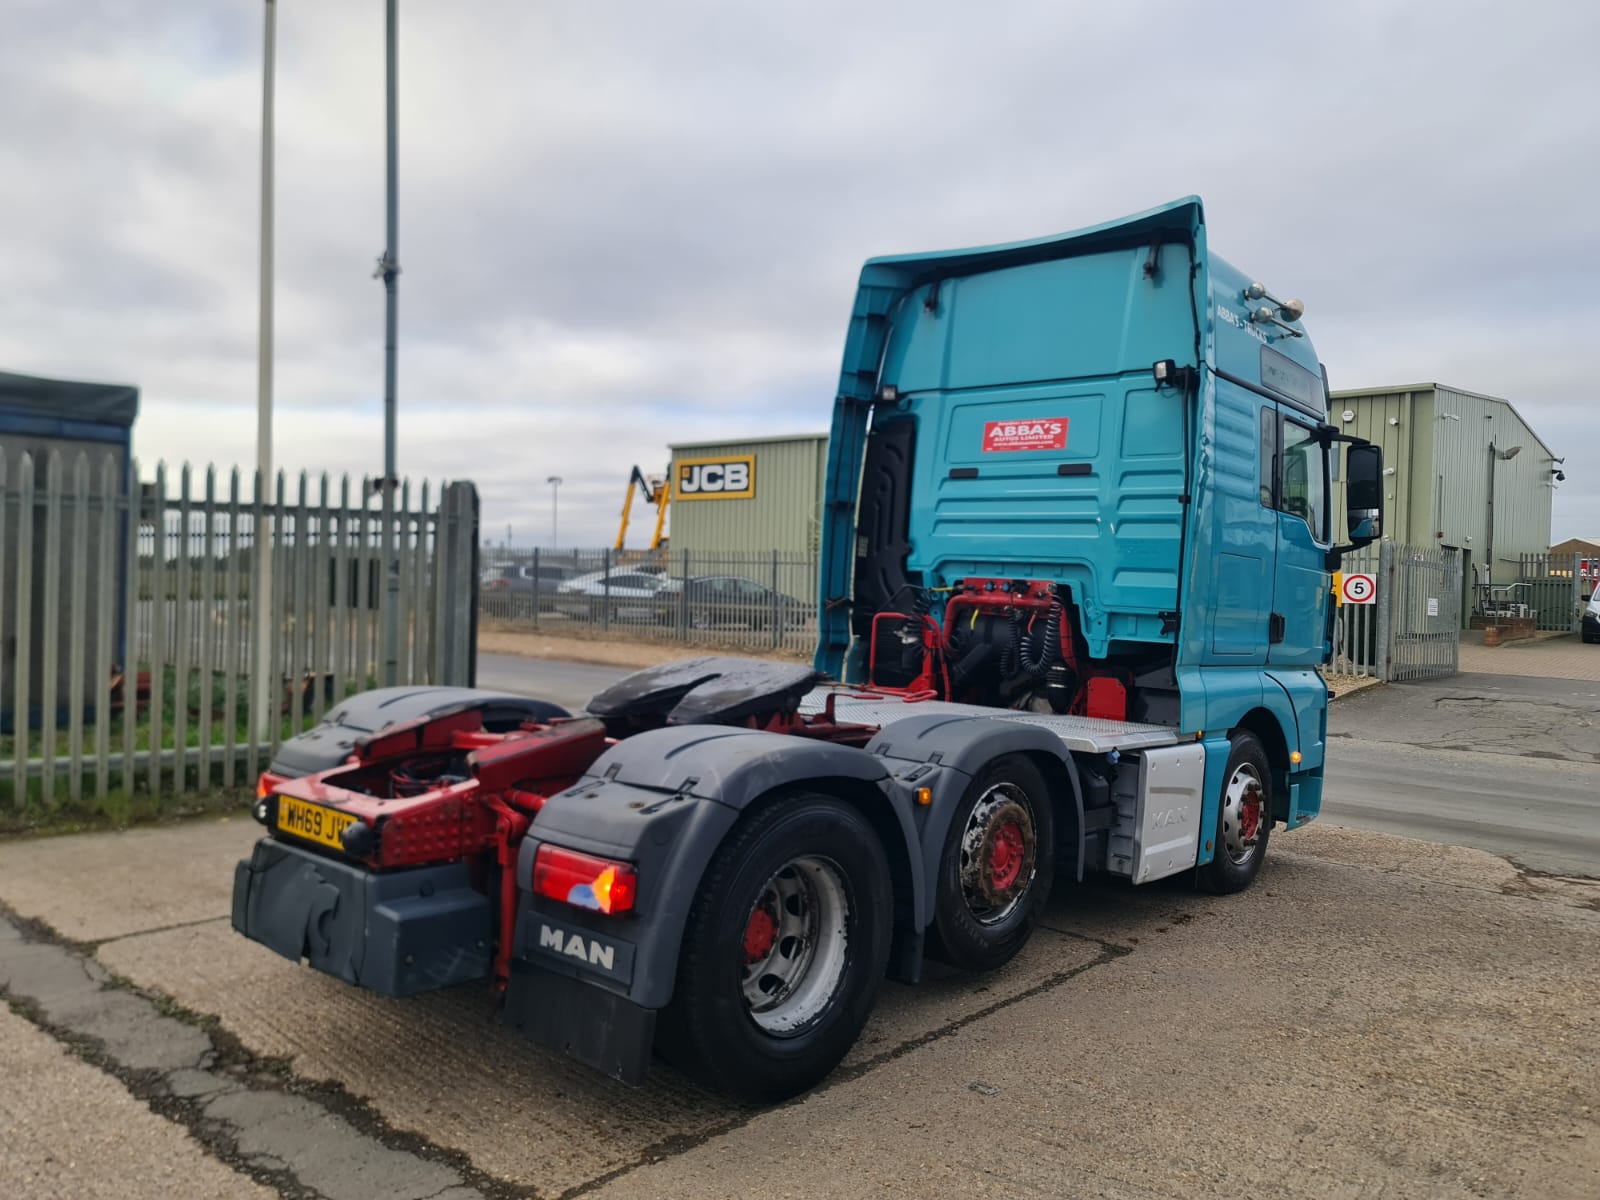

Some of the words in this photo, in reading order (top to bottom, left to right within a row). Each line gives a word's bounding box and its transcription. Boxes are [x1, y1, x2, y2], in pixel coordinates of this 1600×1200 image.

[989, 423, 1062, 438] ABBA'S
[681, 463, 749, 493] JCB
[1354, 582, 1365, 595] 5
[287, 802, 323, 836] WH69
[540, 924, 615, 970] MAN
